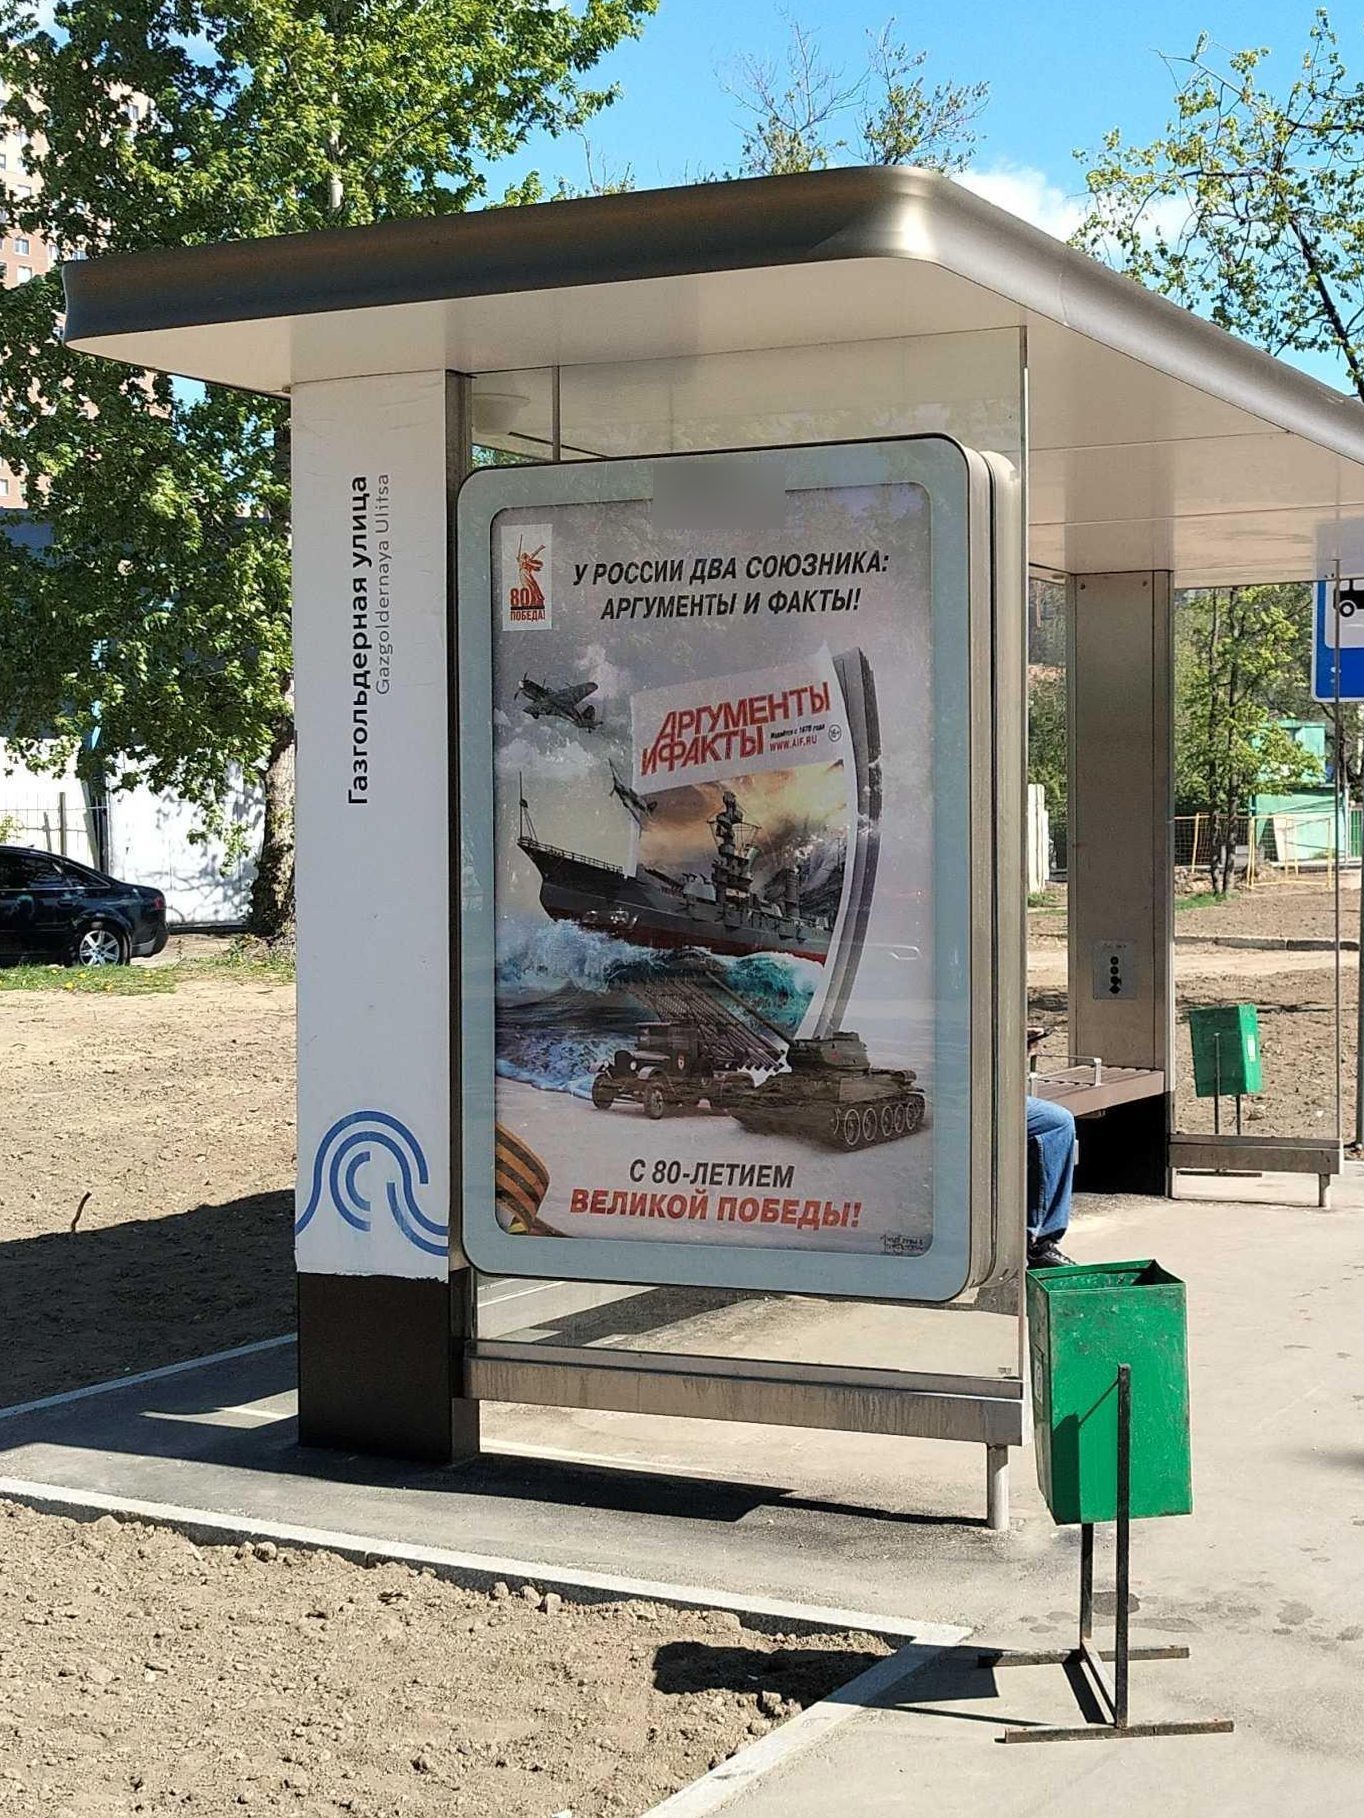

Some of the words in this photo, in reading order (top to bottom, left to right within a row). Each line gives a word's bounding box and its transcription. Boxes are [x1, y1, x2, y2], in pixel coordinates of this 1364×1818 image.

[351, 475, 373, 568] улица
[375, 473, 390, 534] Ulitsa
[573, 563, 588, 585] У
[593, 559, 684, 585] РОССИИ
[689, 557, 737, 584] ДВА
[745, 550, 890, 579] СОЮЗНИКА:
[375, 540, 393, 695] Gazgoldernaya
[510, 587, 530, 607] 80
[510, 609, 546, 622] ПОБЕДА!
[600, 592, 738, 620] АРГУМЕНТЫ
[743, 591, 761, 614] И
[767, 588, 862, 614] ФАКТЫ!
[348, 577, 373, 805] Газгольдерная
[657, 682, 831, 743] АРГУМЕНТЫ
[629, 1158, 646, 1183] С
[651, 1159, 796, 1189] 80-ЛЕТИЕМ
[569, 1187, 711, 1220] ВЕЛИКОЙ
[717, 1195, 863, 1231] ПОБЕДЫ!
